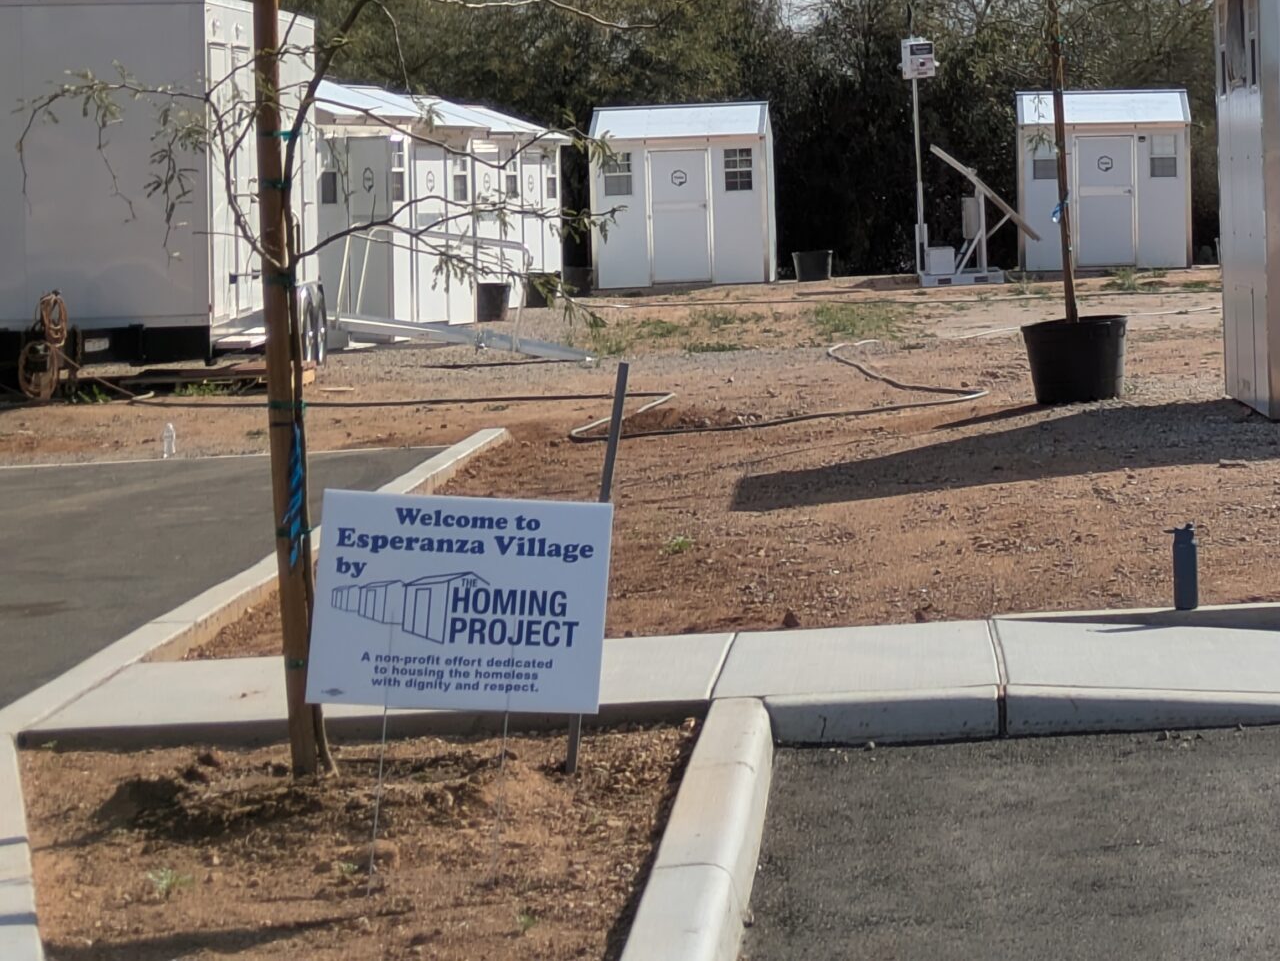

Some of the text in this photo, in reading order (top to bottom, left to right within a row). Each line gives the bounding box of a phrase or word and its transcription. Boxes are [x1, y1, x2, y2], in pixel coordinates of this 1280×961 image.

[395, 506, 541, 532] Welcome to
[335, 526, 595, 564] Esperanza Village
[335, 555, 367, 578] by
[460, 577, 479, 589] THE
[451, 586, 569, 618] HOMING
[449, 616, 580, 648] PROJECT
[361, 651, 554, 670] A non-profit effort dedicated
[373, 665, 539, 682] to housing the homeless
[371, 676, 540, 695] with dignity and respect.
